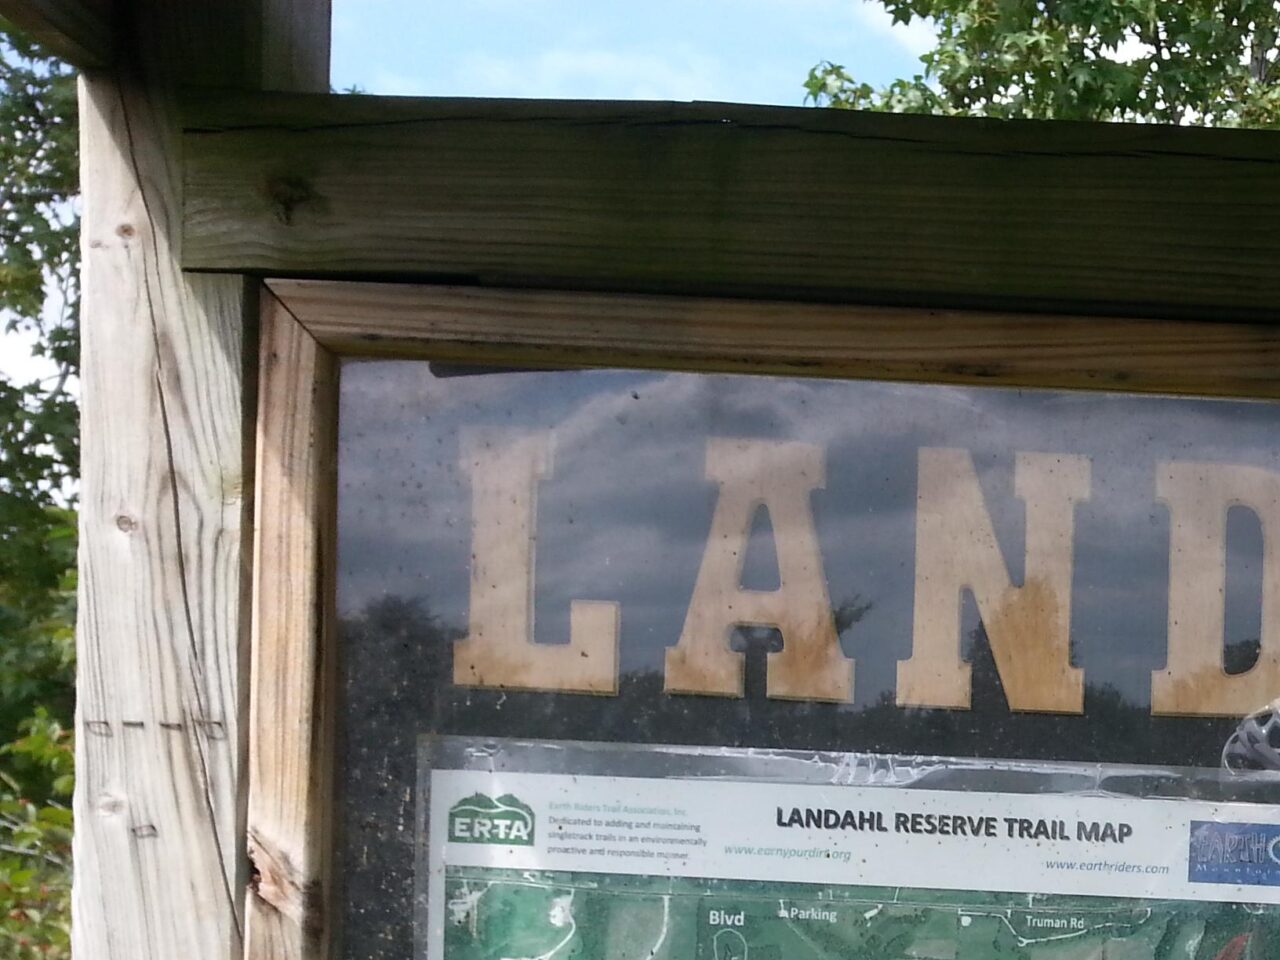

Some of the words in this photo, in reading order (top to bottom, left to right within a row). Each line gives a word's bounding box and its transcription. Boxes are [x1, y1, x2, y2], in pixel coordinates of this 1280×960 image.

[454, 817, 529, 841] ERTA
[593, 817, 603, 827] to
[605, 818, 633, 829] adding
[635, 820, 650, 829] and
[776, 806, 888, 832] LANDAHL
[894, 812, 998, 838] RESERVE
[1004, 817, 1070, 841] TRAIL
[1077, 821, 1132, 844] MAP
[628, 835, 639, 843] an
[588, 846, 605, 856] and
[723, 842, 852, 862] www.earnyourdirt.org
[1046, 858, 1170, 876] www.earthriders.com
[708, 909, 745, 926] Blvd
[790, 907, 838, 923] Parking
[1026, 914, 1067, 929] Truman
[1070, 916, 1085, 930] Rd
